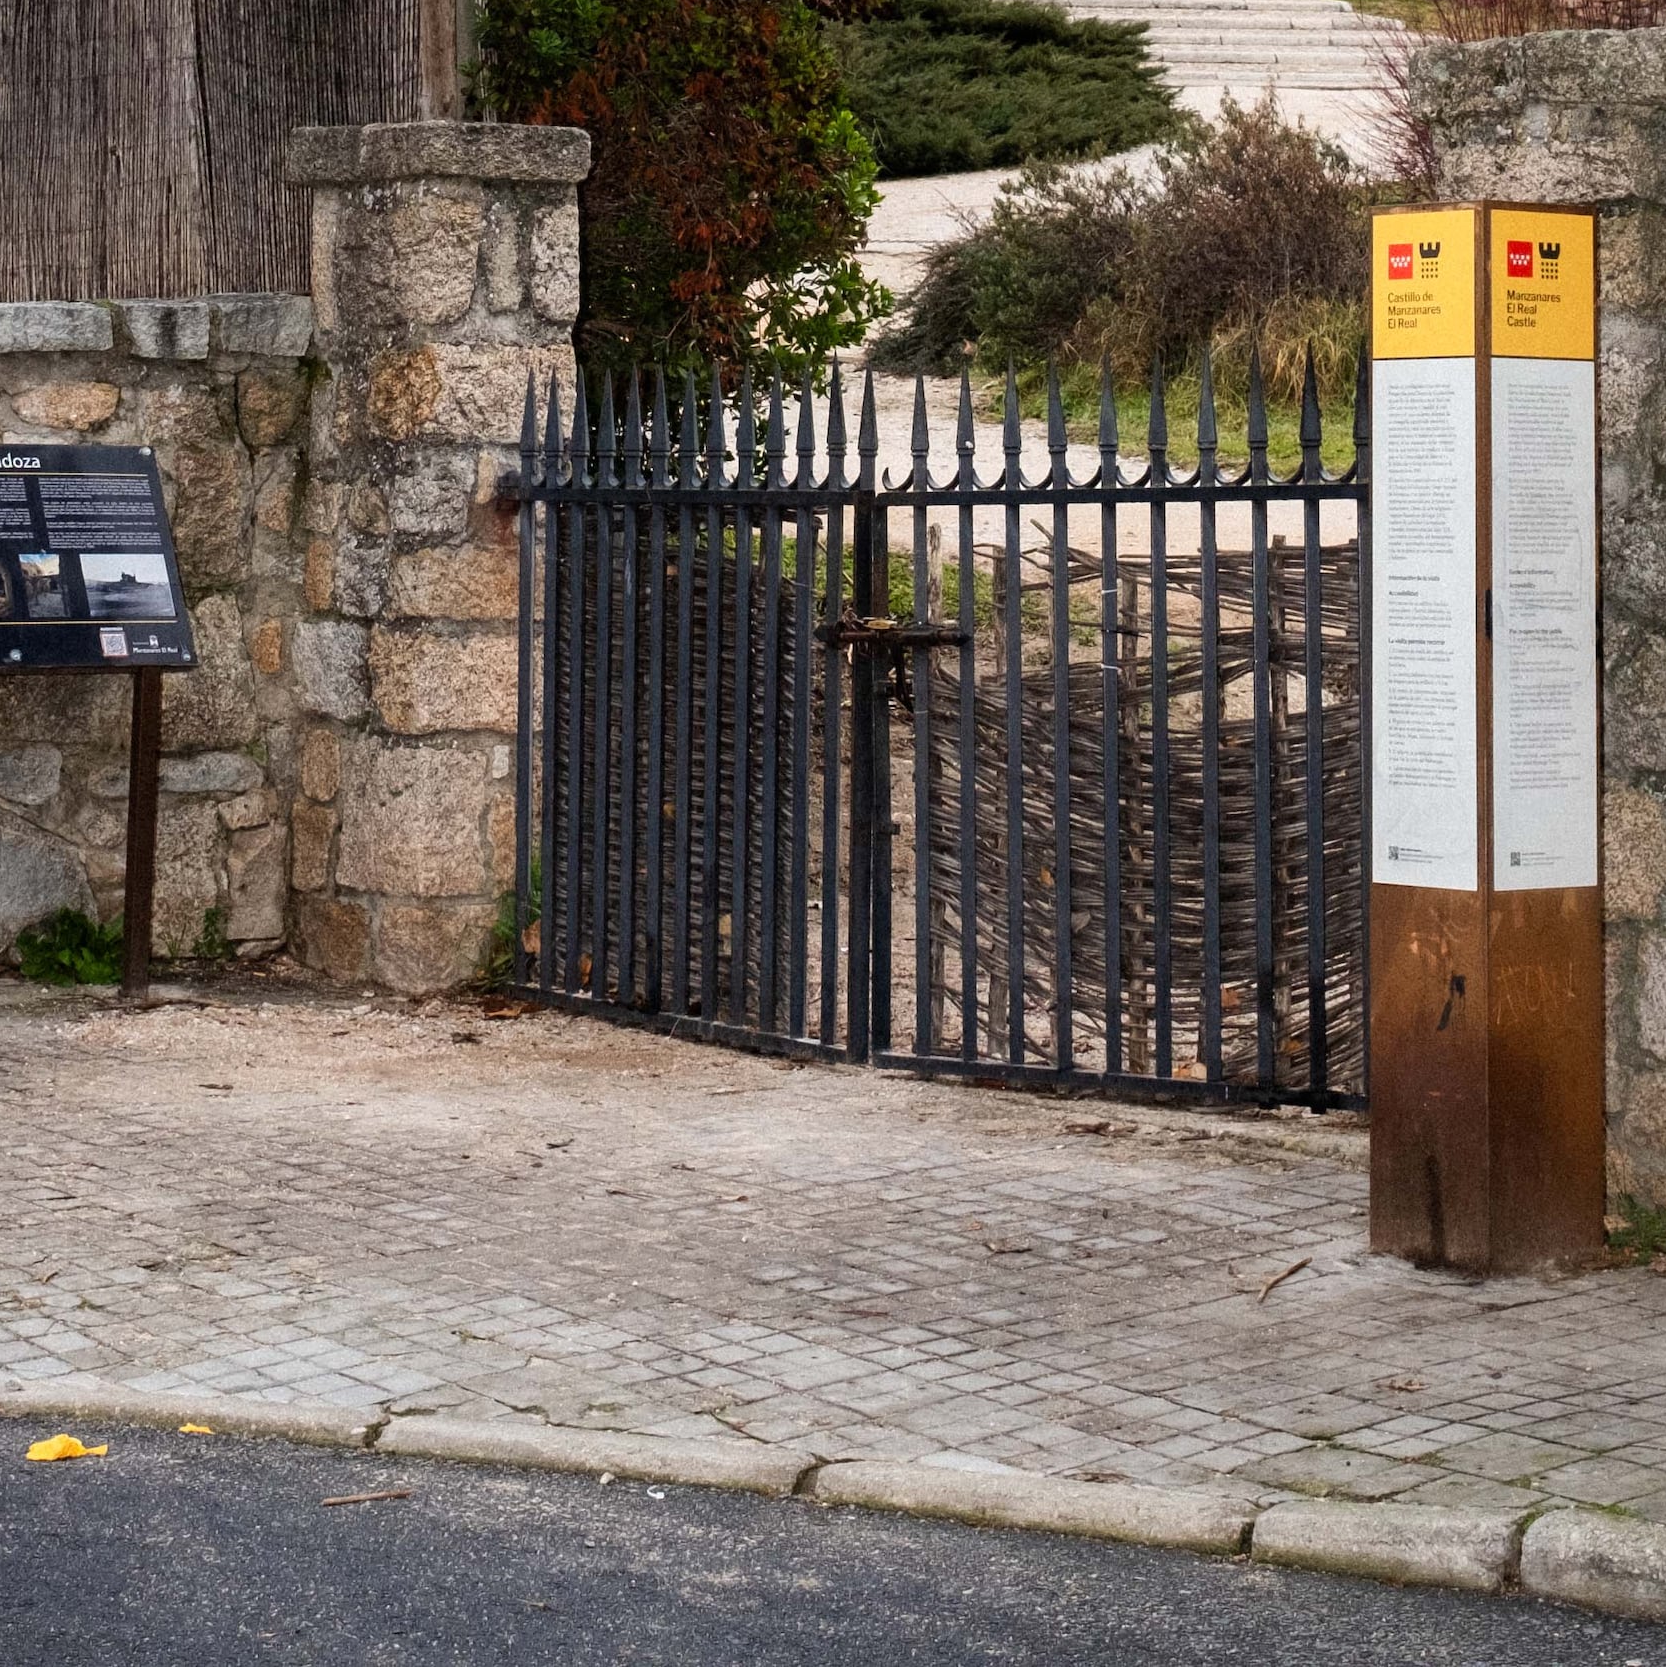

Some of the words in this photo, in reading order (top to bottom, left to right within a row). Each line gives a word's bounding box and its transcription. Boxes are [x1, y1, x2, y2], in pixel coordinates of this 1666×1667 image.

[1388, 292, 1421, 303] Castillo
[1422, 293, 1433, 302] de
[1507, 290, 1561, 302] Manzanares
[1388, 305, 1441, 315] Manzanares
[1507, 303, 1515, 314] El
[1517, 304, 1537, 314] Real
[1388, 319, 1396, 329] El
[1398, 318, 1417, 328] Real
[1507, 316, 1536, 327] Castle
